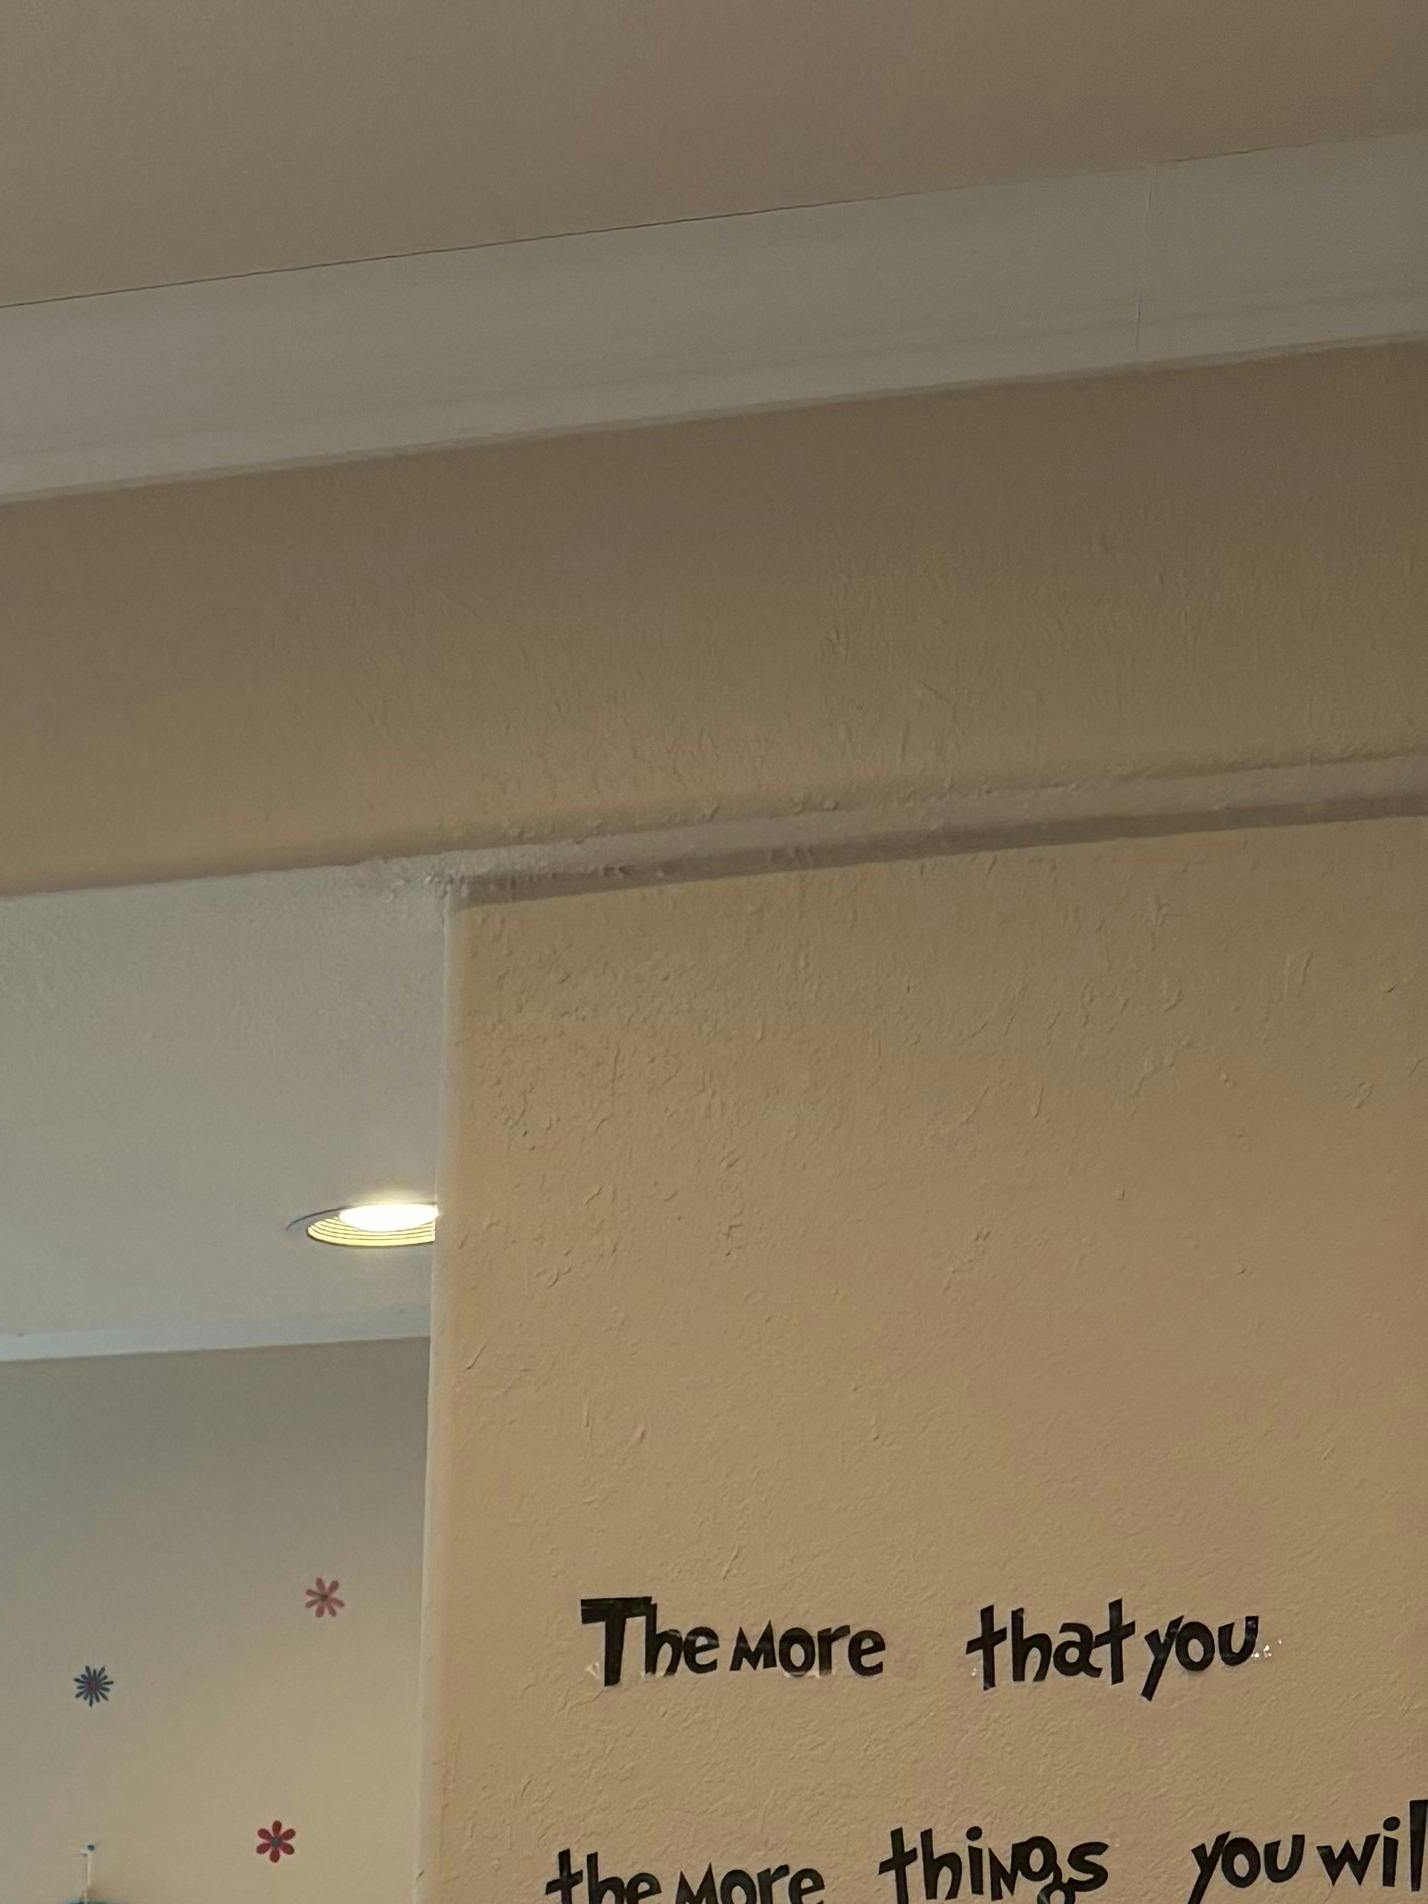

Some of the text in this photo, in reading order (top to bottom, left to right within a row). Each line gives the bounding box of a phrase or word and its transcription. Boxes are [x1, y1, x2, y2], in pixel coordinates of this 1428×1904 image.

[580, 1596, 720, 1687] The
[965, 1598, 1136, 1691] that
[1140, 1615, 1259, 1702] you
[1316, 1799, 1428, 1892] wil
